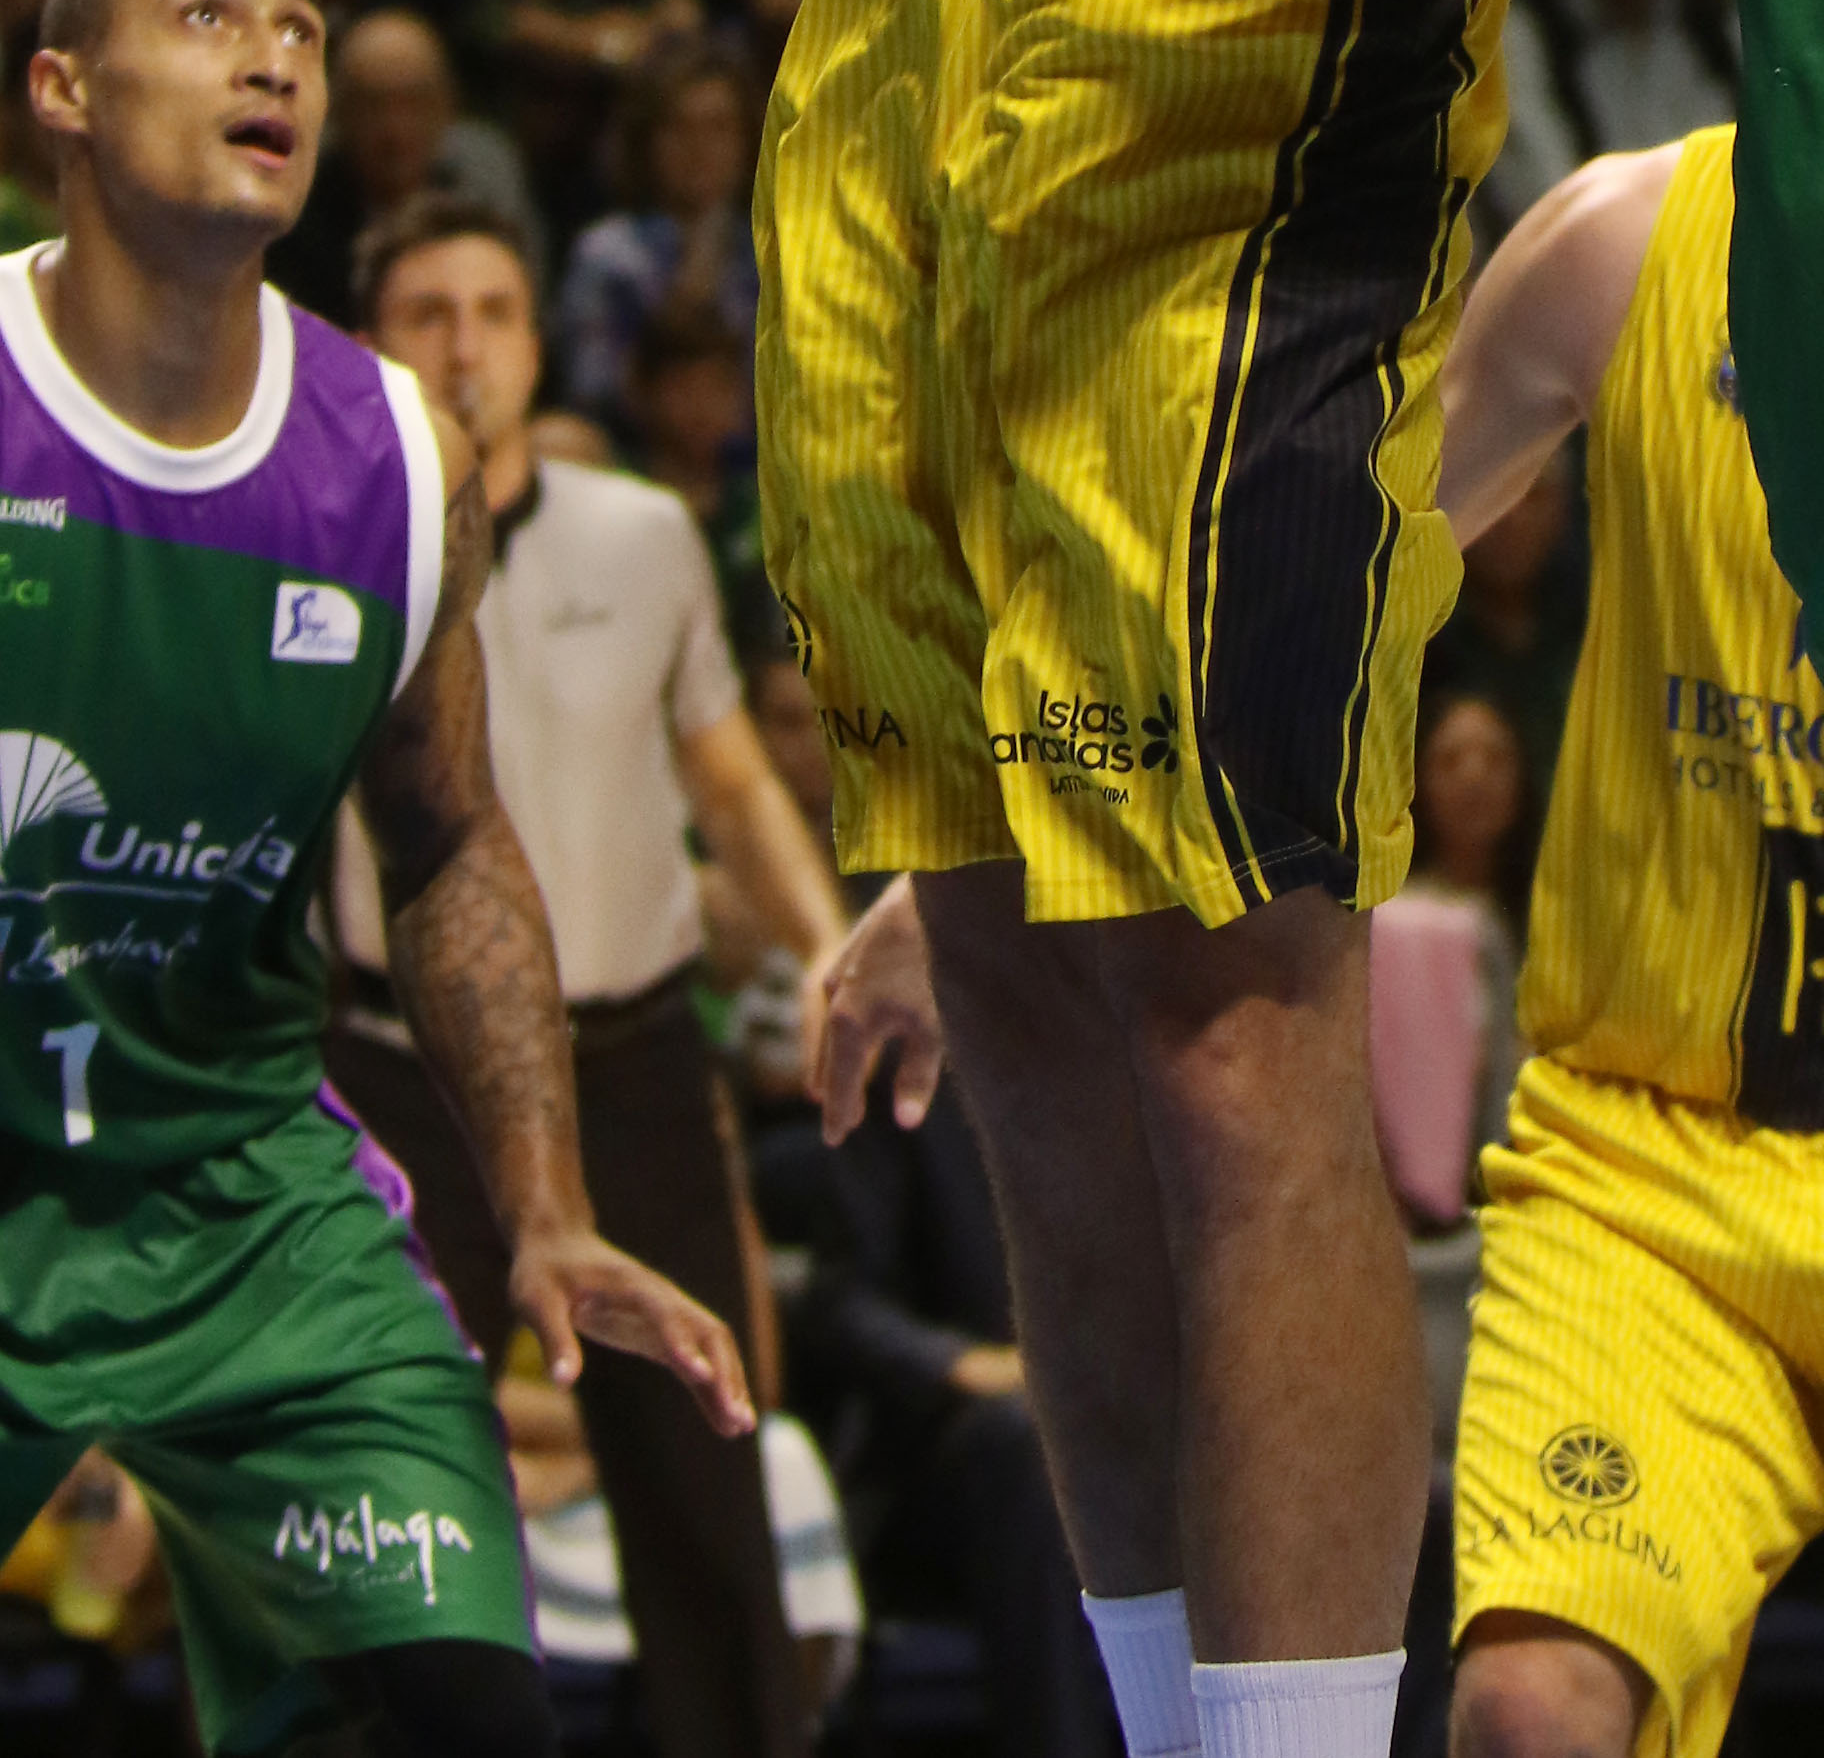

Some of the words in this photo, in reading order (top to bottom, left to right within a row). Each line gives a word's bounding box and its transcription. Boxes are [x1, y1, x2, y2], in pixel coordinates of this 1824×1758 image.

[989, 729, 1135, 773] anarias
[1039, 689, 1129, 736] Islas
[41, 1020, 101, 1147] 1
[273, 1492, 474, 1608] Málaga
